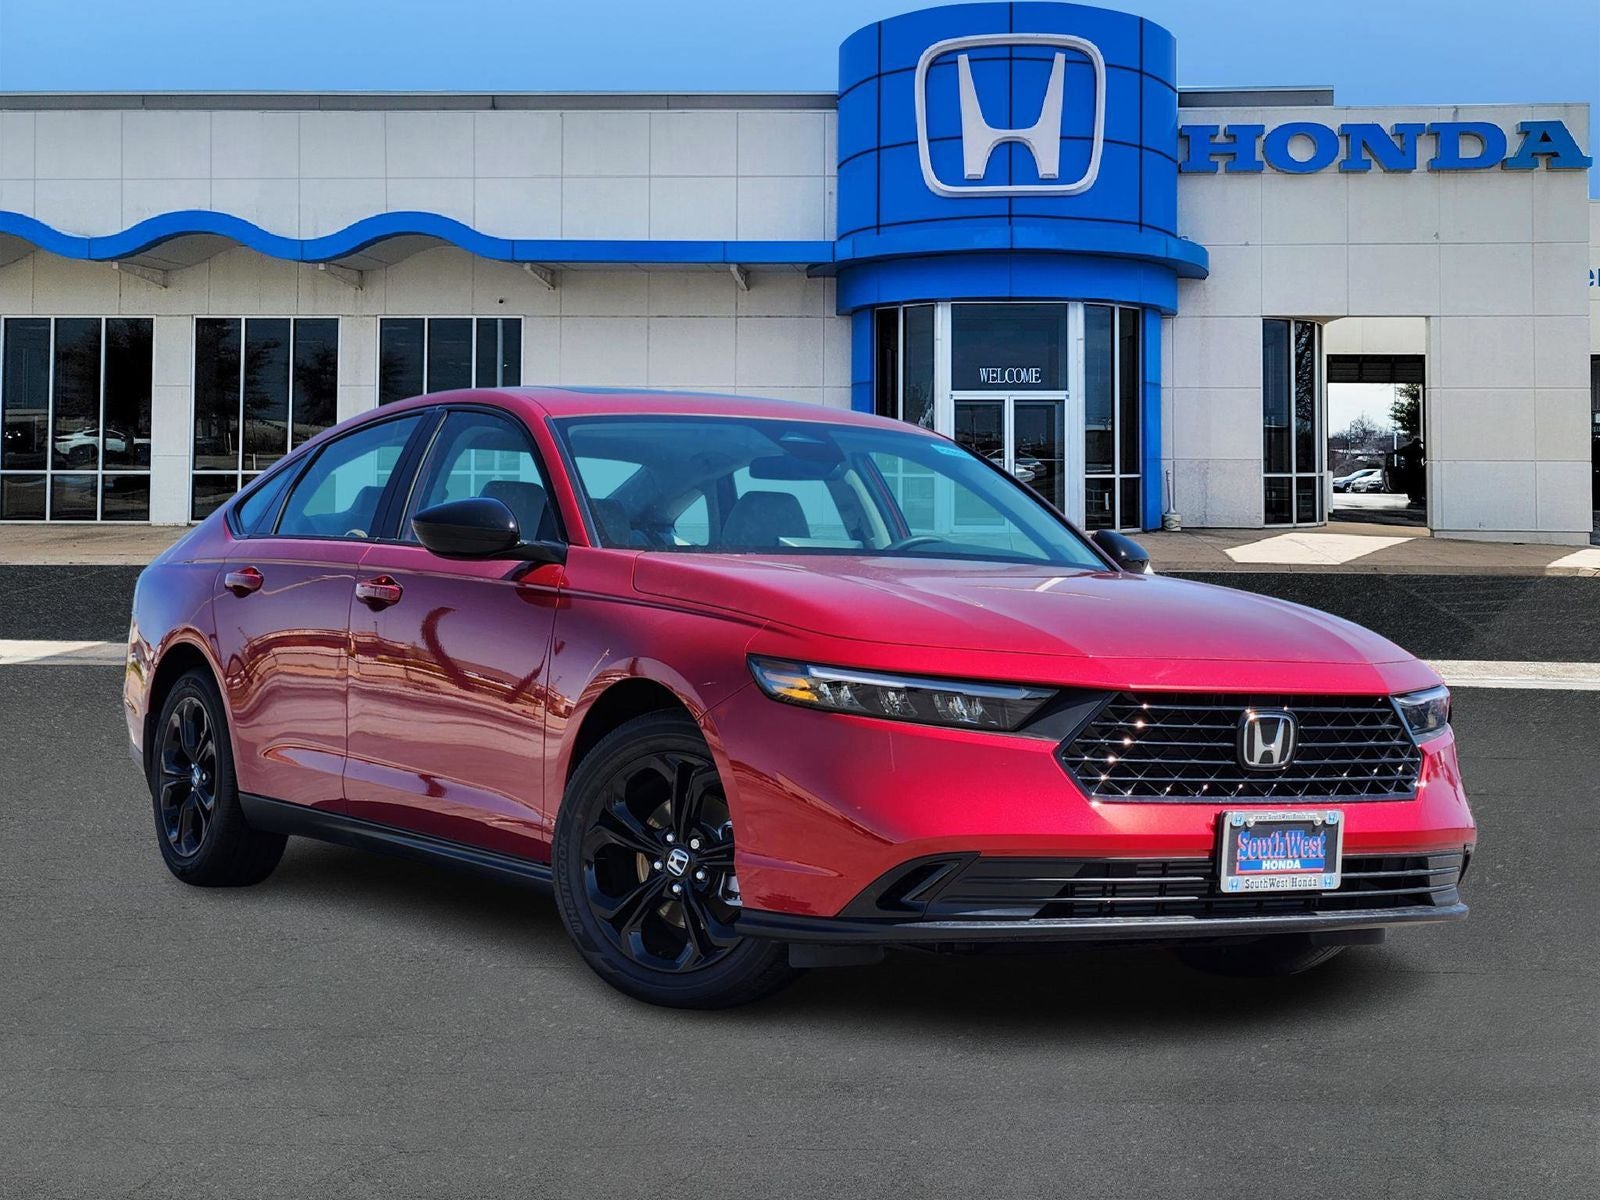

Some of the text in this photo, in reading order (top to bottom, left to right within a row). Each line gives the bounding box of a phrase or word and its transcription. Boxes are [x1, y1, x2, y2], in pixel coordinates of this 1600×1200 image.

[1178, 121, 1593, 174] HONDA
[979, 367, 1041, 384] WELCOME
[1237, 830, 1326, 860] SouthWest
[1262, 860, 1300, 870] HONDA
[1244, 877, 1317, 889] SouthWest Honda
